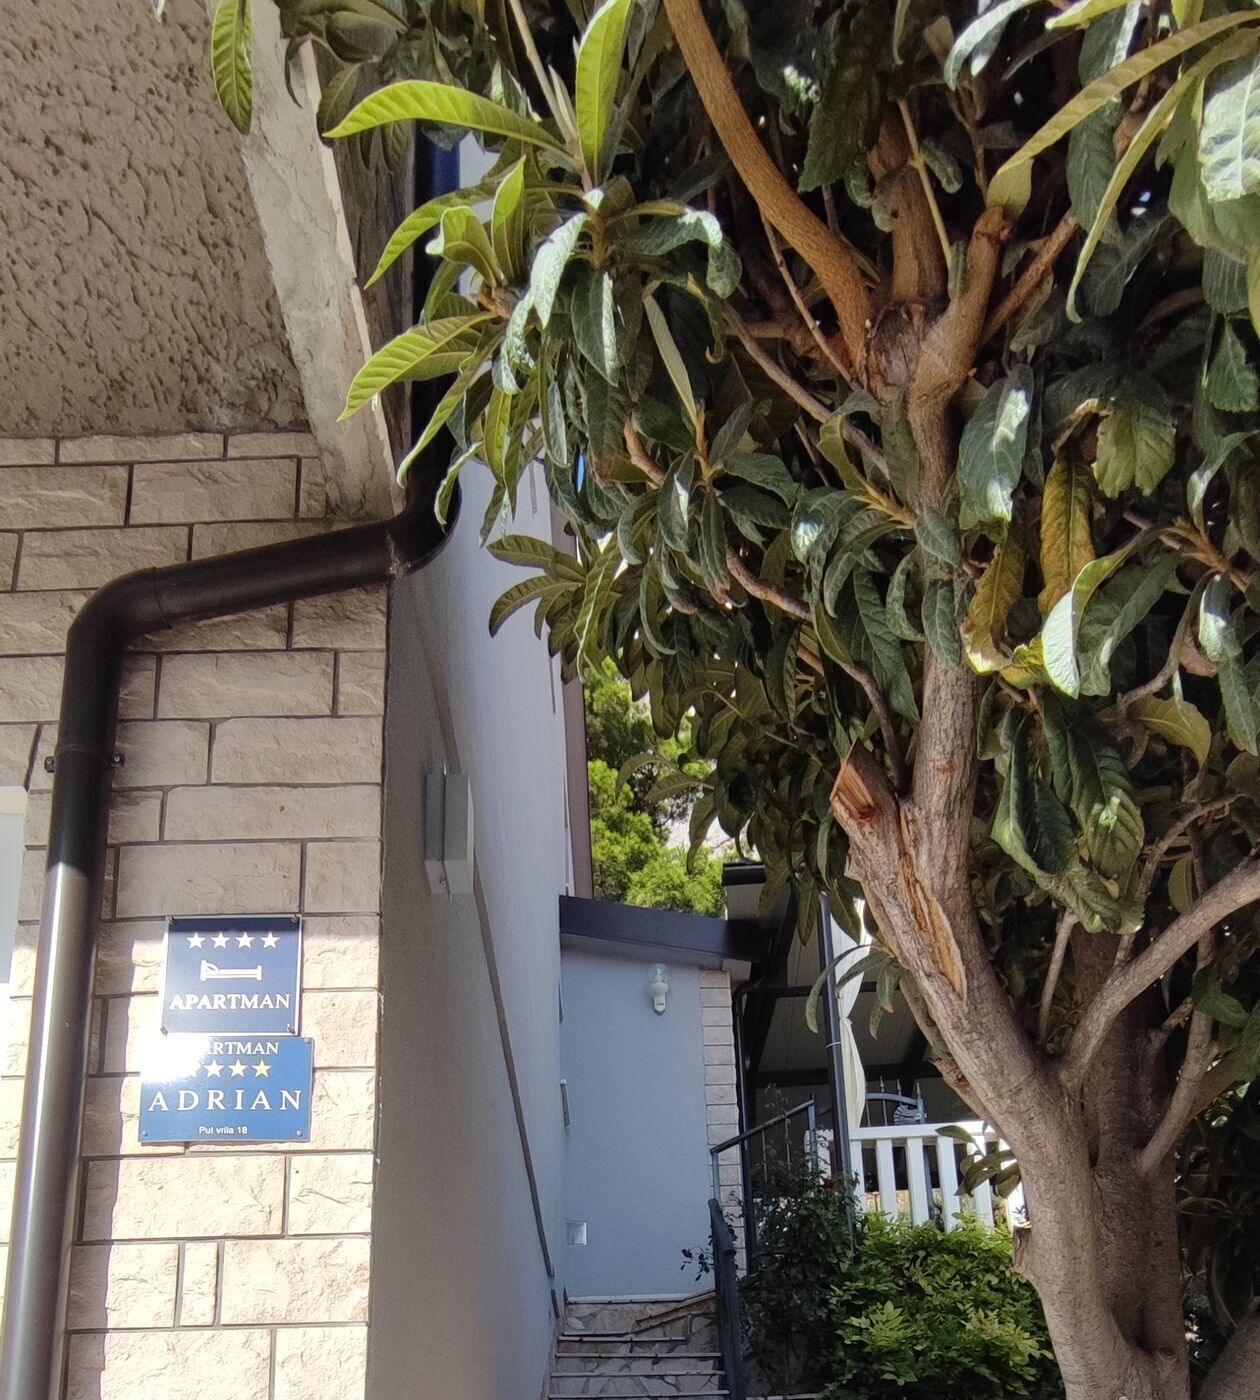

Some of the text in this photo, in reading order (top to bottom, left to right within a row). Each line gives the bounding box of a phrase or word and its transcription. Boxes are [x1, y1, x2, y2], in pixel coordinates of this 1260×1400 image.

[169, 993, 291, 1010] APARTMAN
[147, 1089, 301, 1112] ADRIAN
[198, 1126, 214, 1135] Put
[236, 1126, 248, 1135] 18
